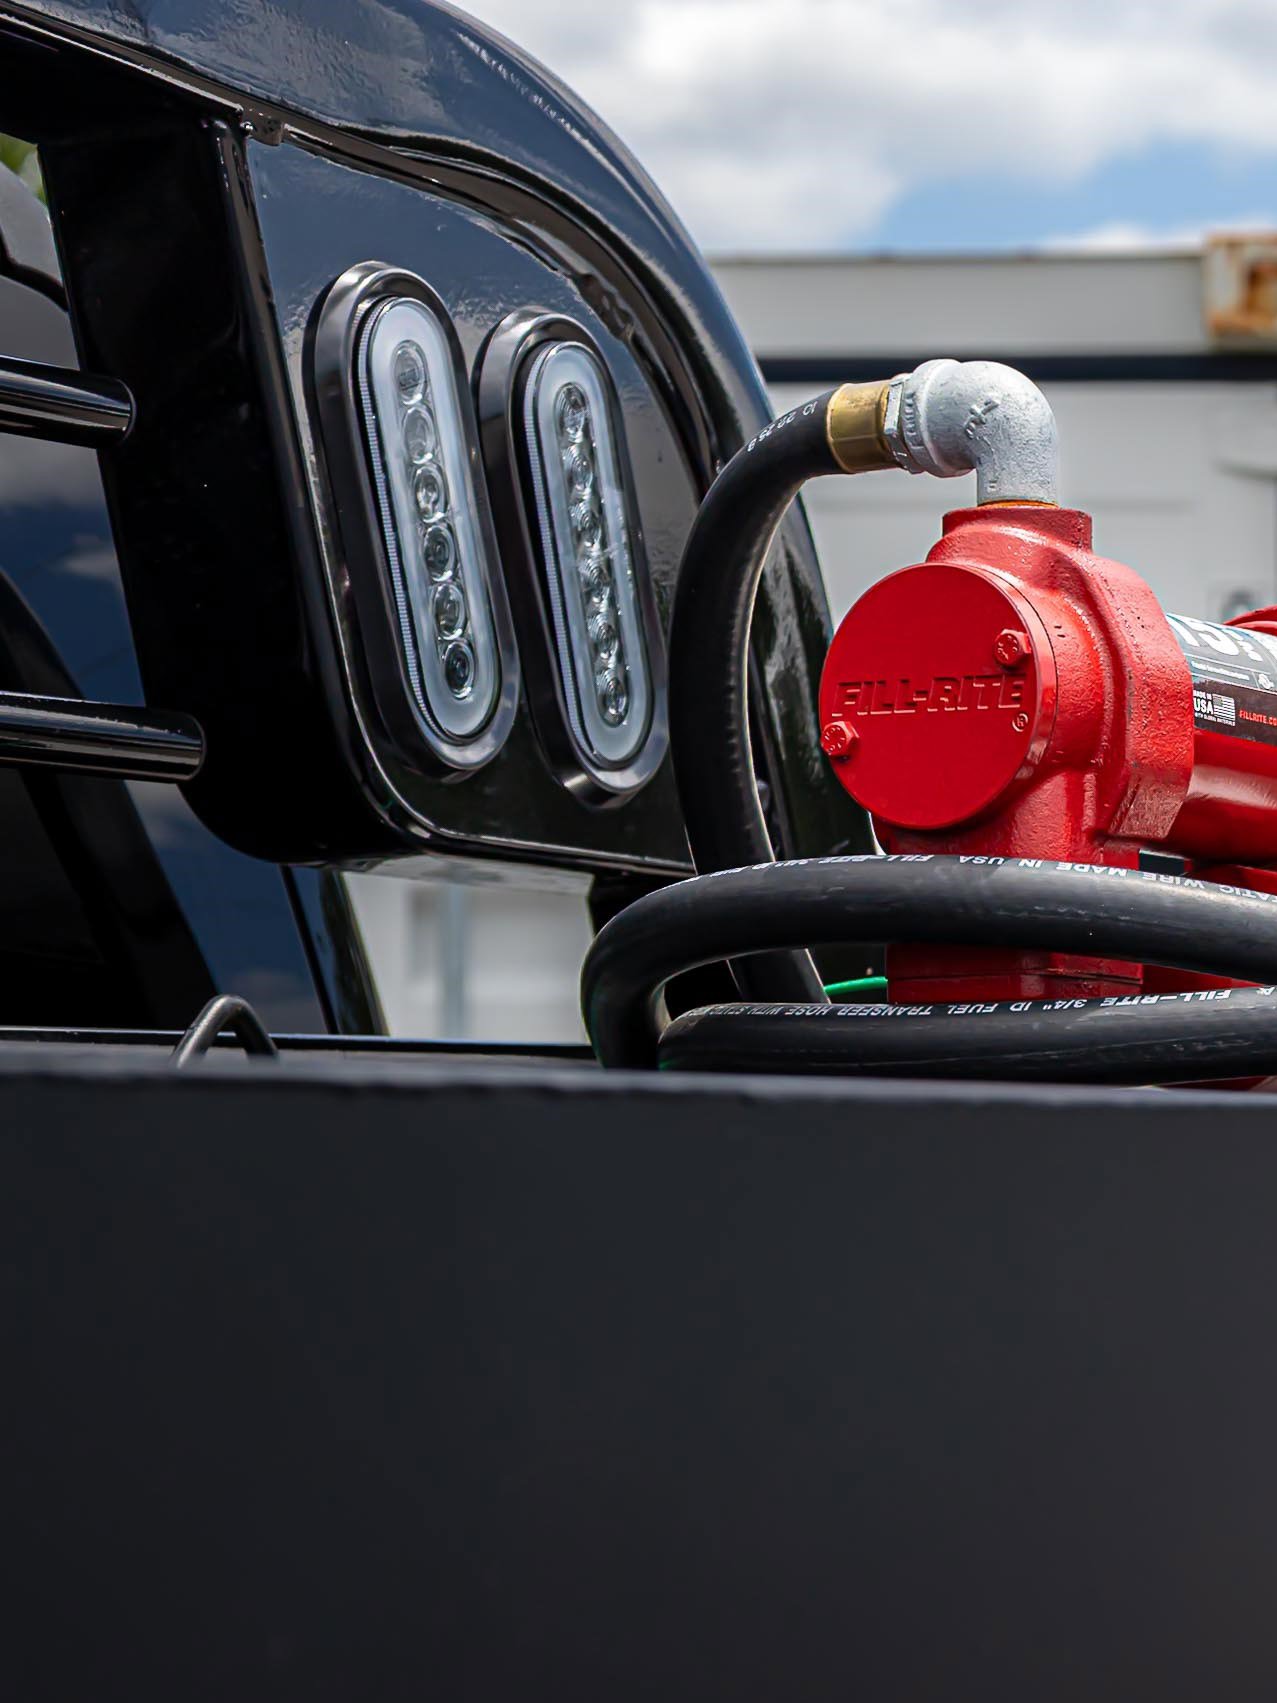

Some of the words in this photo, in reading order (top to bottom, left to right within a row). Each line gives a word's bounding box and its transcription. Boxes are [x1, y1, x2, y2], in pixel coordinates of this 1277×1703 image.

[832, 673, 1026, 717] FILL-RITE
[1193, 697, 1214, 715] USA
[959, 855, 1005, 865] USA
[1018, 859, 1043, 868] IN
[1055, 861, 1128, 878] MADE
[1142, 872, 1205, 890] WIRE
[1043, 999, 1087, 1010] 3/4"
[1100, 990, 1232, 1008] FILL-RITE
[784, 1004, 833, 1016] HOSE
[837, 1004, 932, 1016] TRANSFER
[947, 1003, 999, 1015] FUEL
[1010, 1001, 1033, 1013] ID
